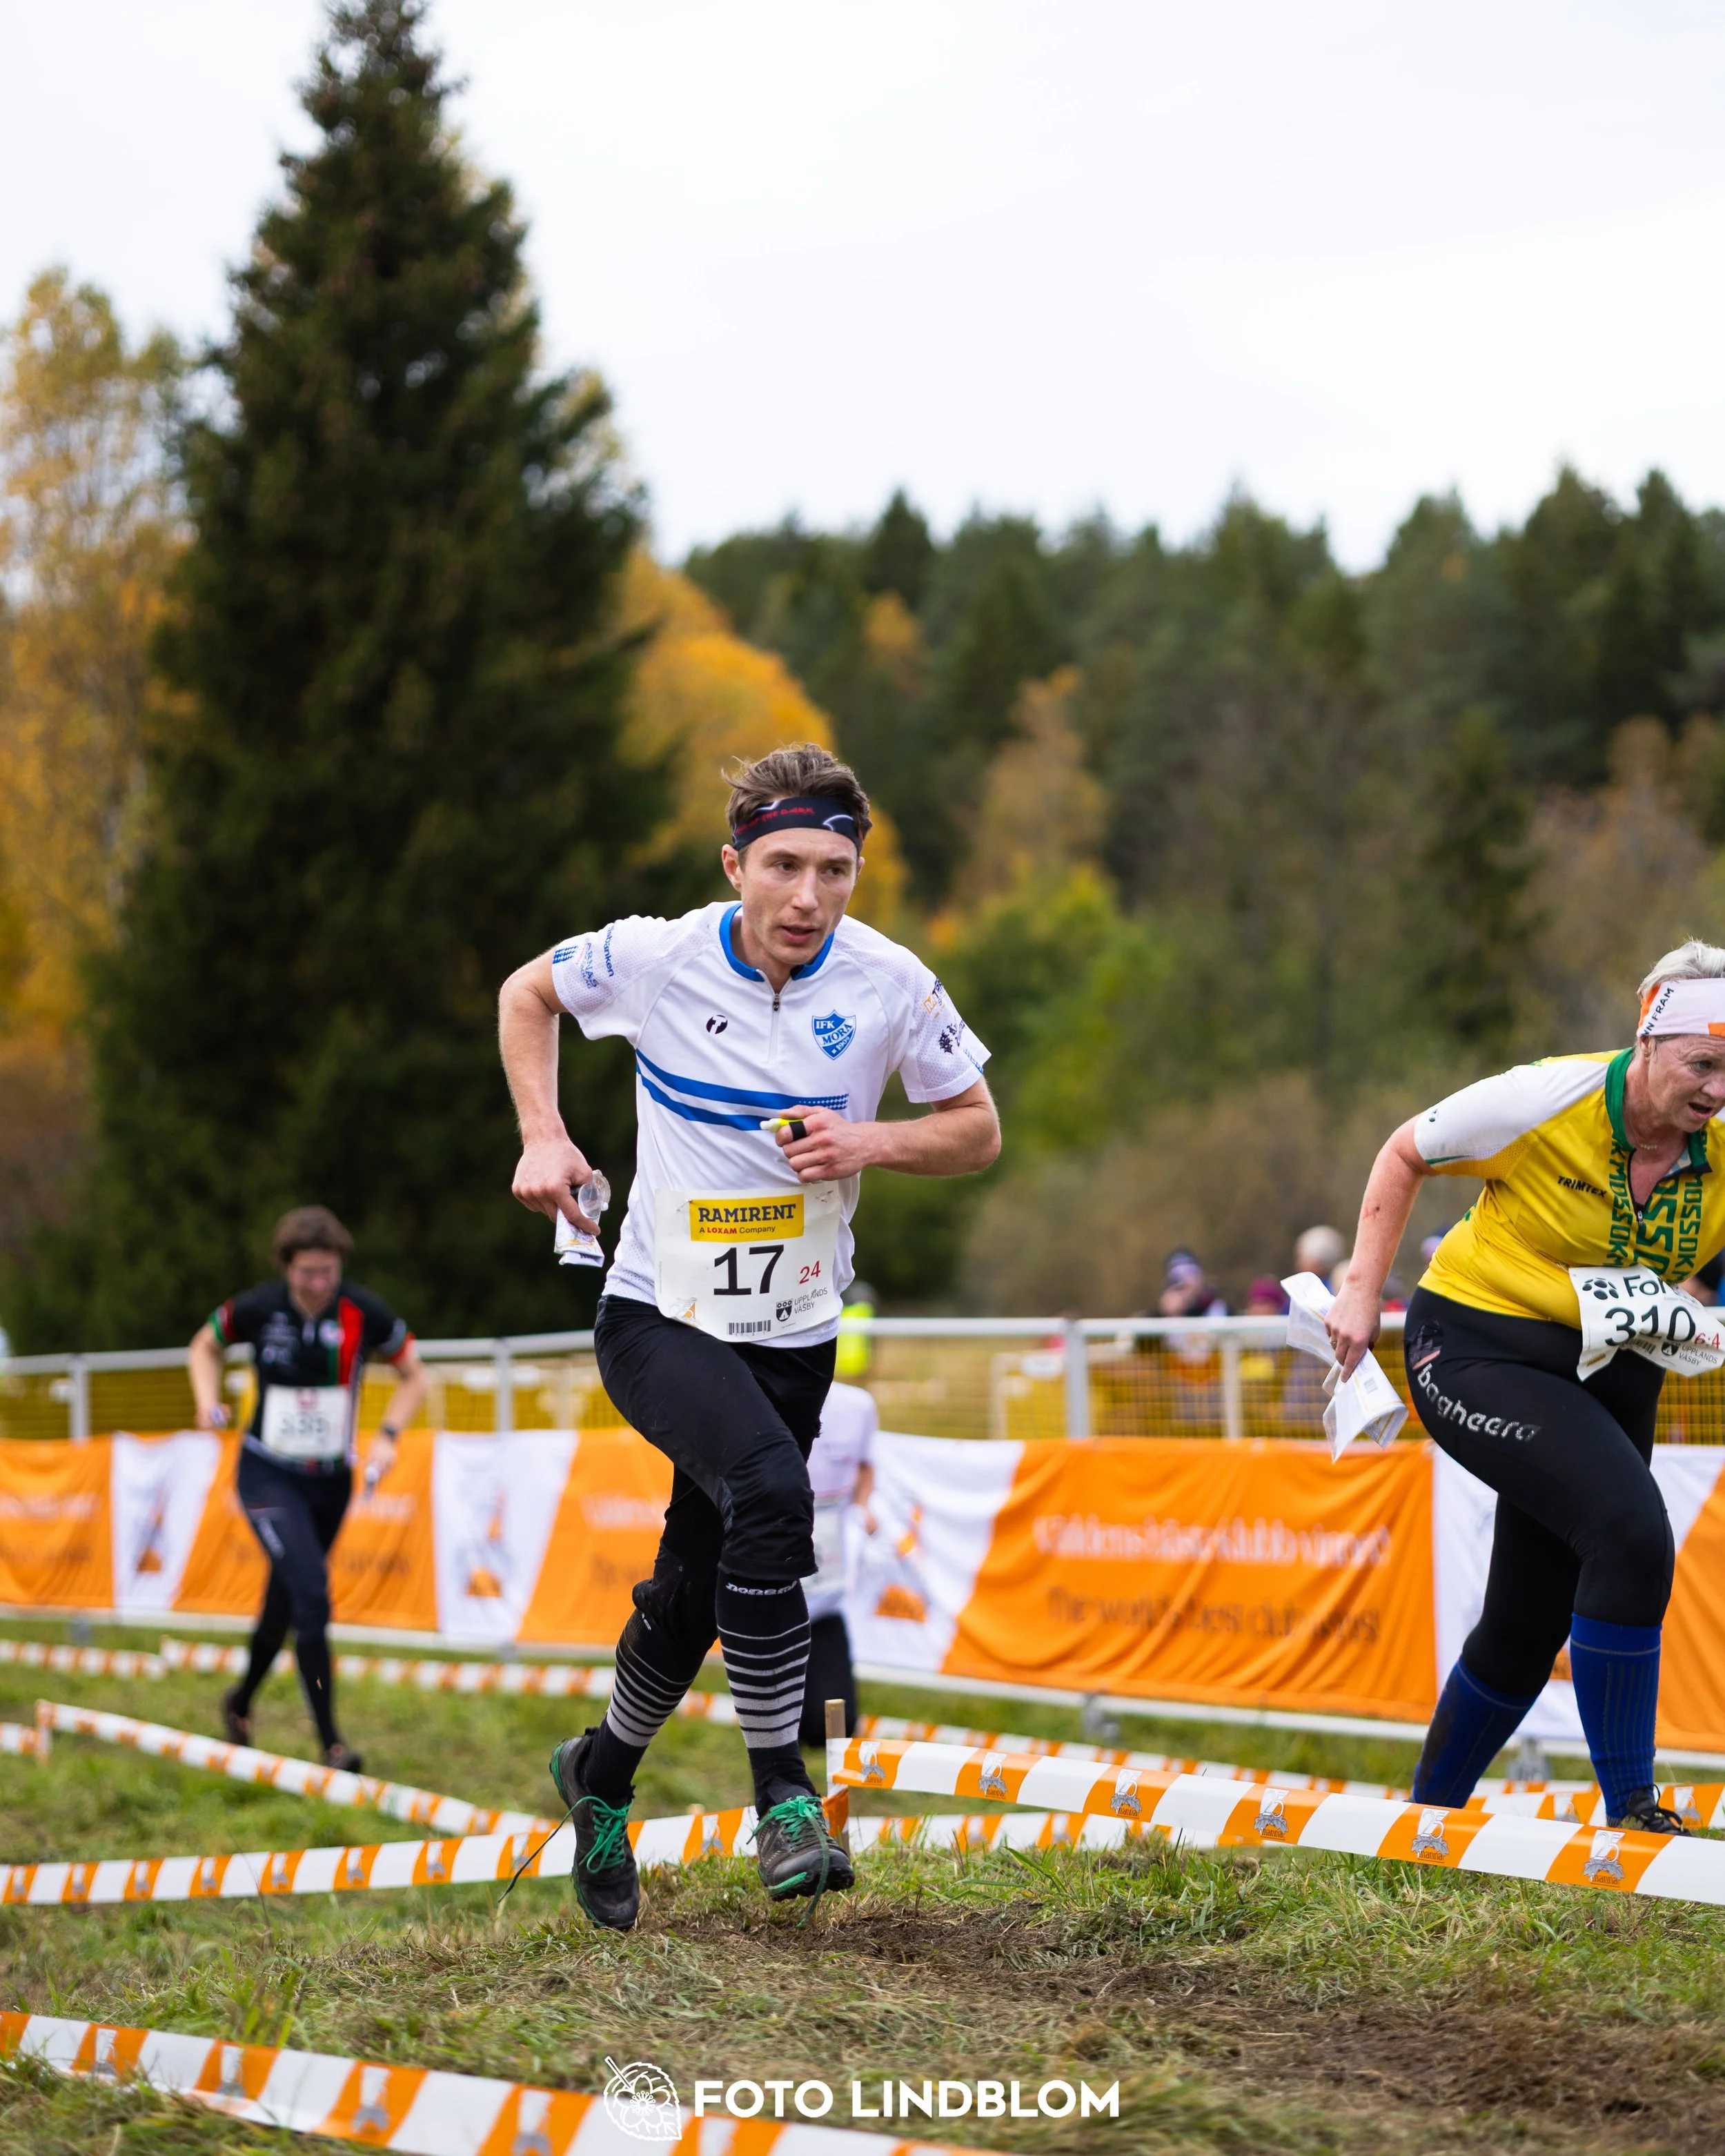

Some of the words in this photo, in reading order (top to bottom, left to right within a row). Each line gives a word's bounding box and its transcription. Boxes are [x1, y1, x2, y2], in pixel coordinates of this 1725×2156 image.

[1651, 987, 1675, 1021] FRAM
[815, 1020, 836, 1029] IFK
[821, 1024, 854, 1045] MORA
[836, 1036, 850, 1051] 1909
[1557, 1175, 1608, 1198] TRIMTEX
[698, 1203, 796, 1223] RAMIRENT
[739, 1225, 776, 1234] Company
[713, 1245, 785, 1296] 17
[799, 1260, 821, 1285] 24
[794, 1287, 829, 1305] UPPLANDS
[794, 1301, 816, 1314] VÄSBY
[1604, 1305, 1696, 1347] 310
[1682, 1345, 1719, 1364] UPPLANDS
